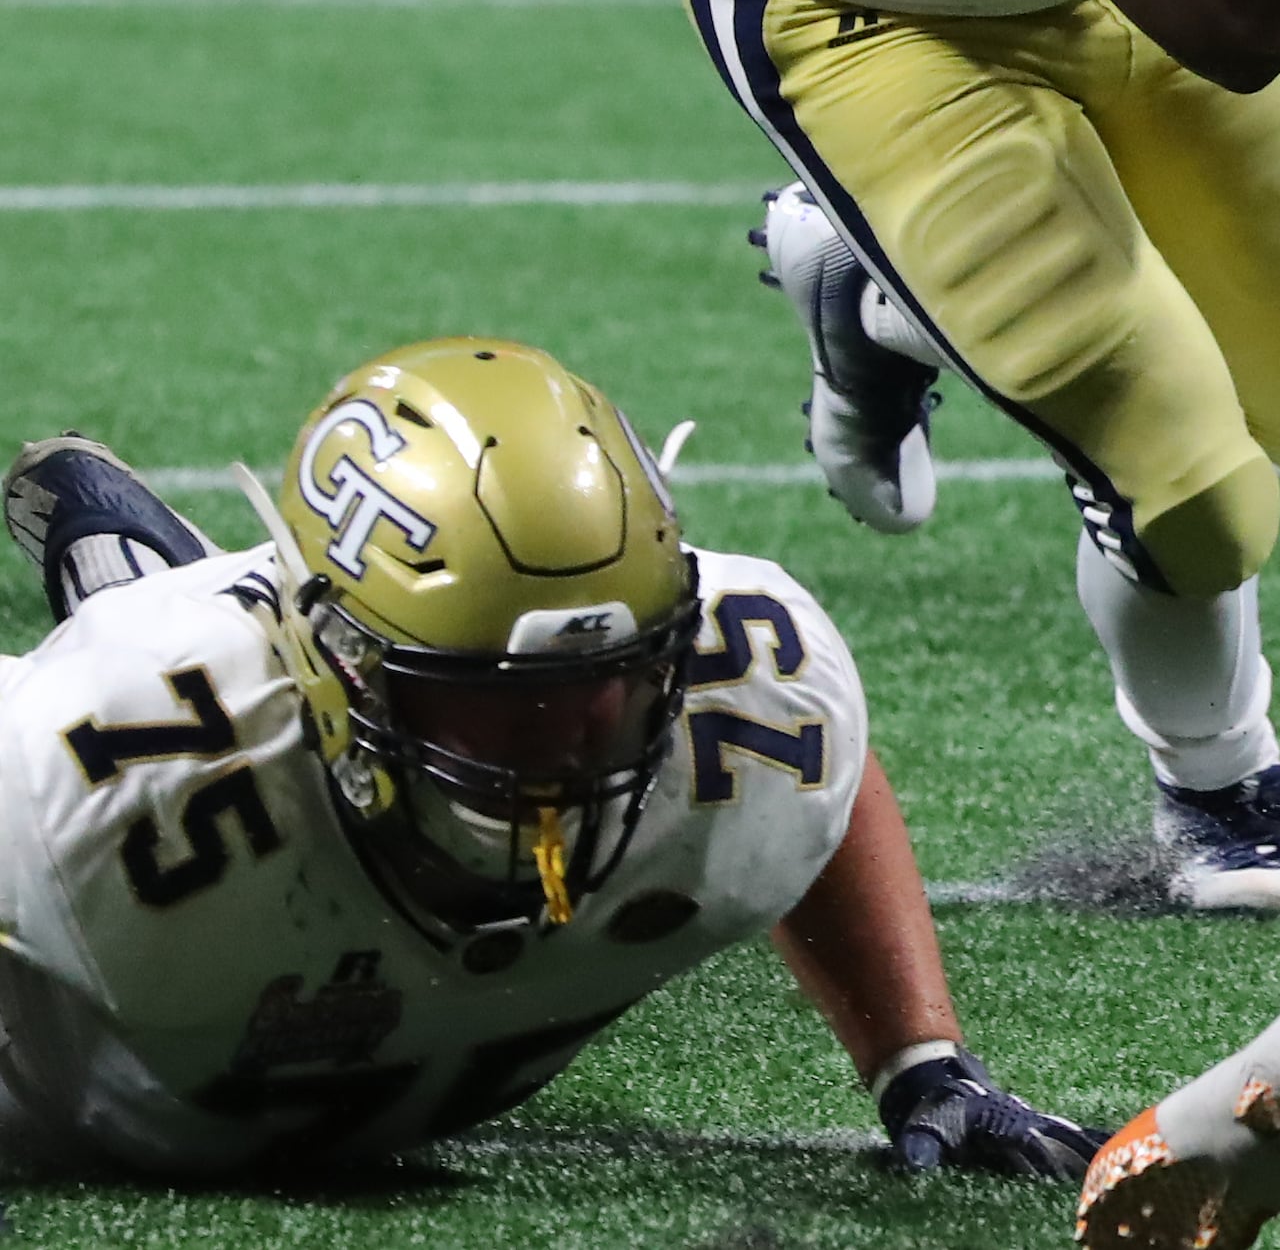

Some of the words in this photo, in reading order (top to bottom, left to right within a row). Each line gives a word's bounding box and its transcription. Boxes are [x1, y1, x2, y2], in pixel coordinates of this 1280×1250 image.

[297, 399, 437, 582] GT
[58, 662, 284, 913] 75
[678, 588, 831, 810] 75
